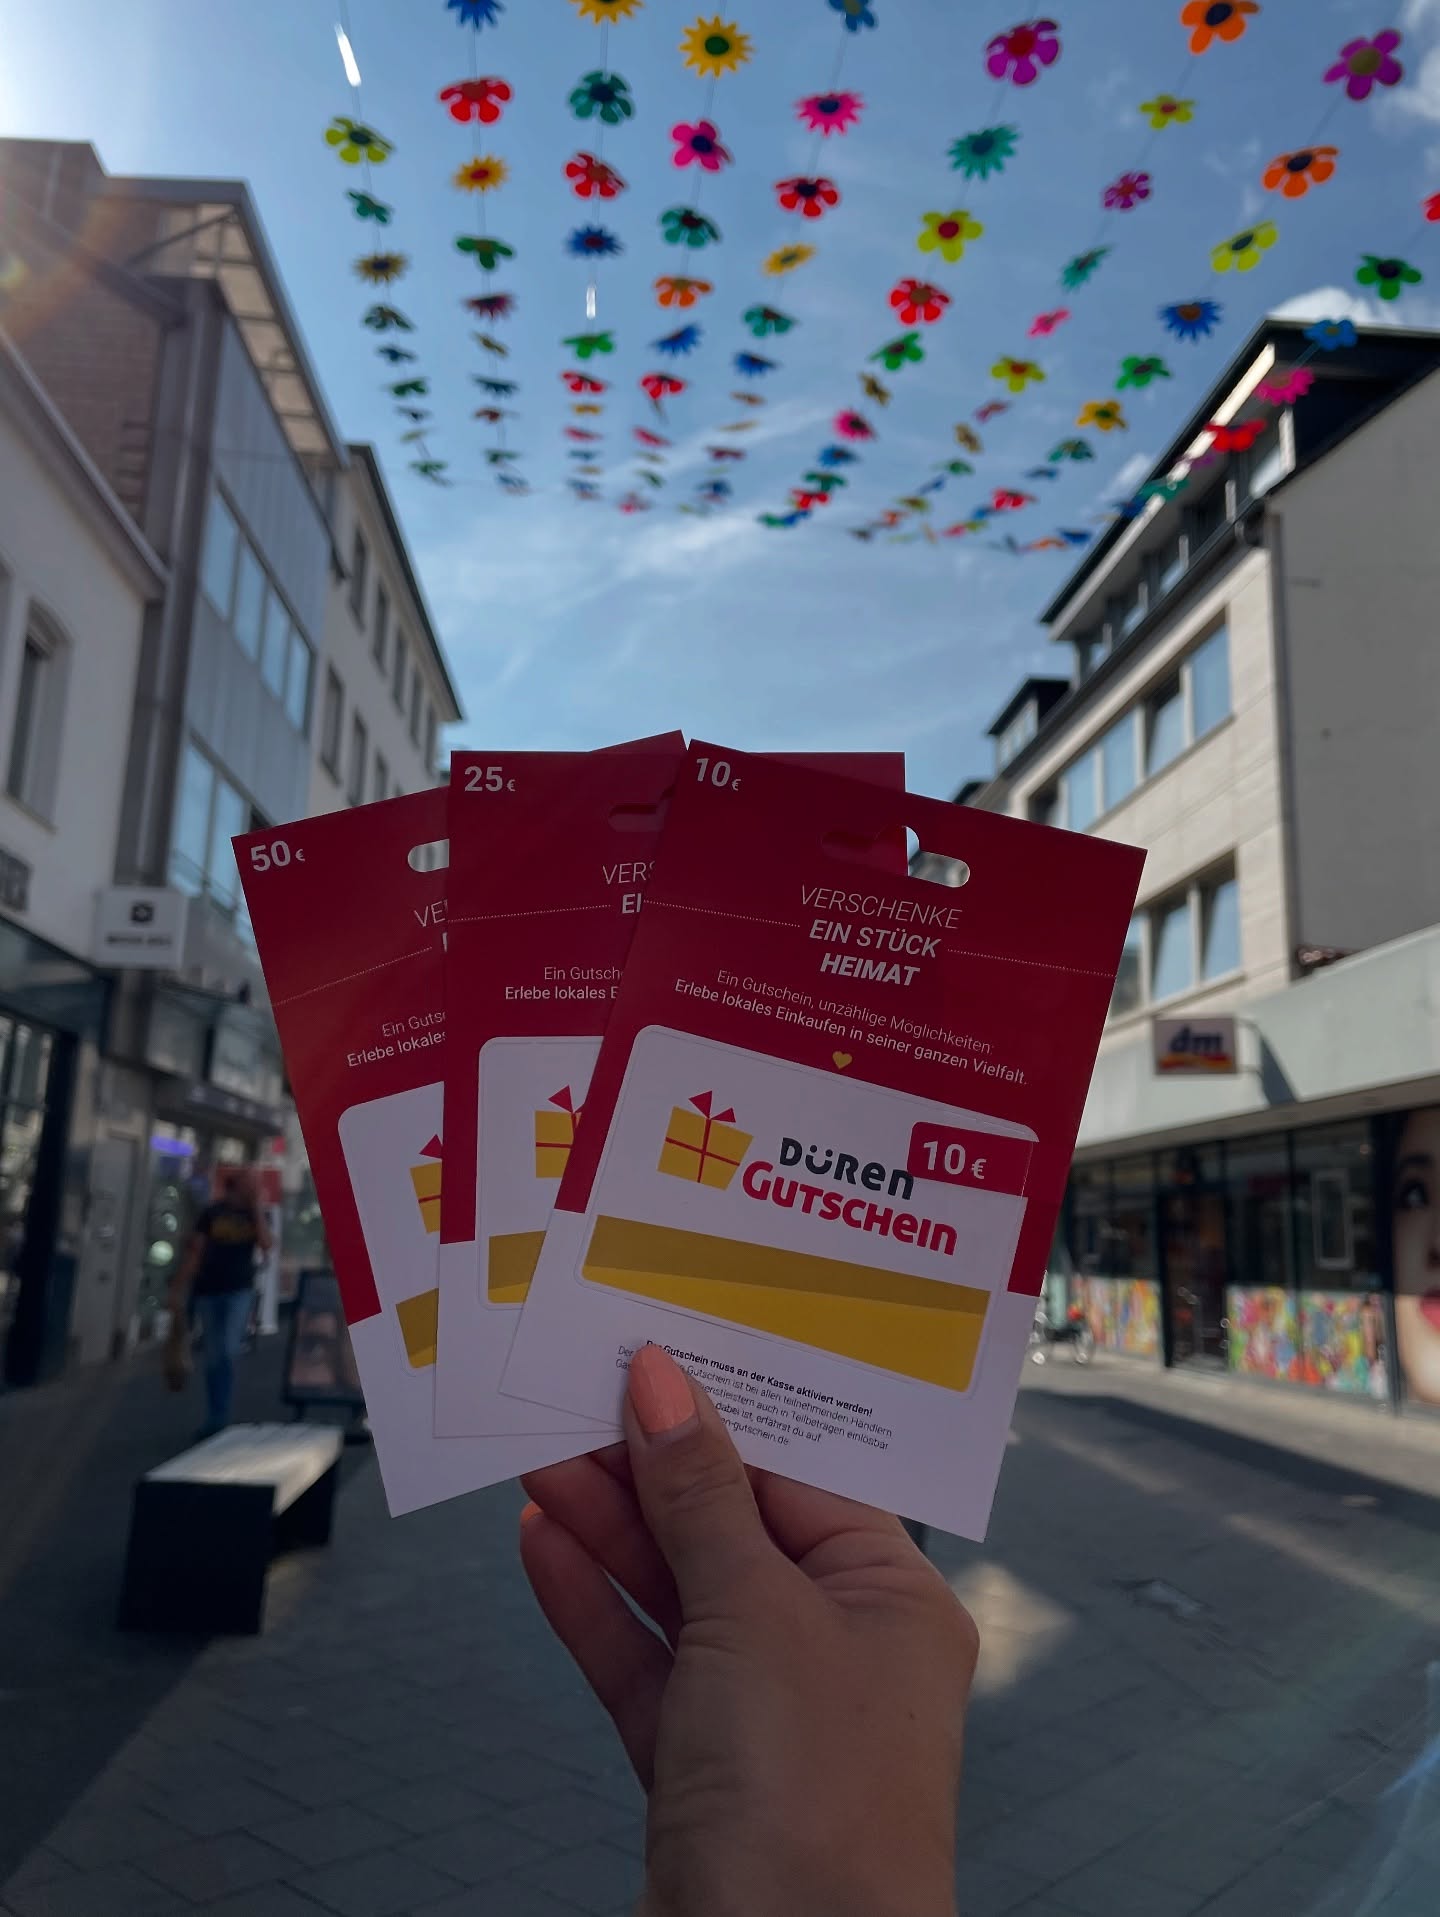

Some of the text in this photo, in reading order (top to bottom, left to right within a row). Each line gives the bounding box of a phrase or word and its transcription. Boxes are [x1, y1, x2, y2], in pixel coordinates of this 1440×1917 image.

[622, 893, 642, 914] EI
[801, 883, 963, 930] VERSCHENKE
[809, 918, 942, 959] EIN STÜCK
[544, 966, 624, 981] Ein Gutsch
[820, 953, 920, 987] HEIMAT
[505, 985, 551, 1000] Erlebe
[554, 985, 606, 1000] lokales
[717, 969, 739, 987] Ein
[742, 976, 815, 1009] Gutschein,
[818, 999, 887, 1027] unzählige
[382, 1021, 405, 1037] Ein
[674, 978, 1028, 1085] Erlebe lokales Einkaufen in seiner ganzen Vielfalt.
[347, 1046, 395, 1067] Erlebe
[663, 1345, 873, 1417] Gutschein muss an der Kasse aktiviert werden!
